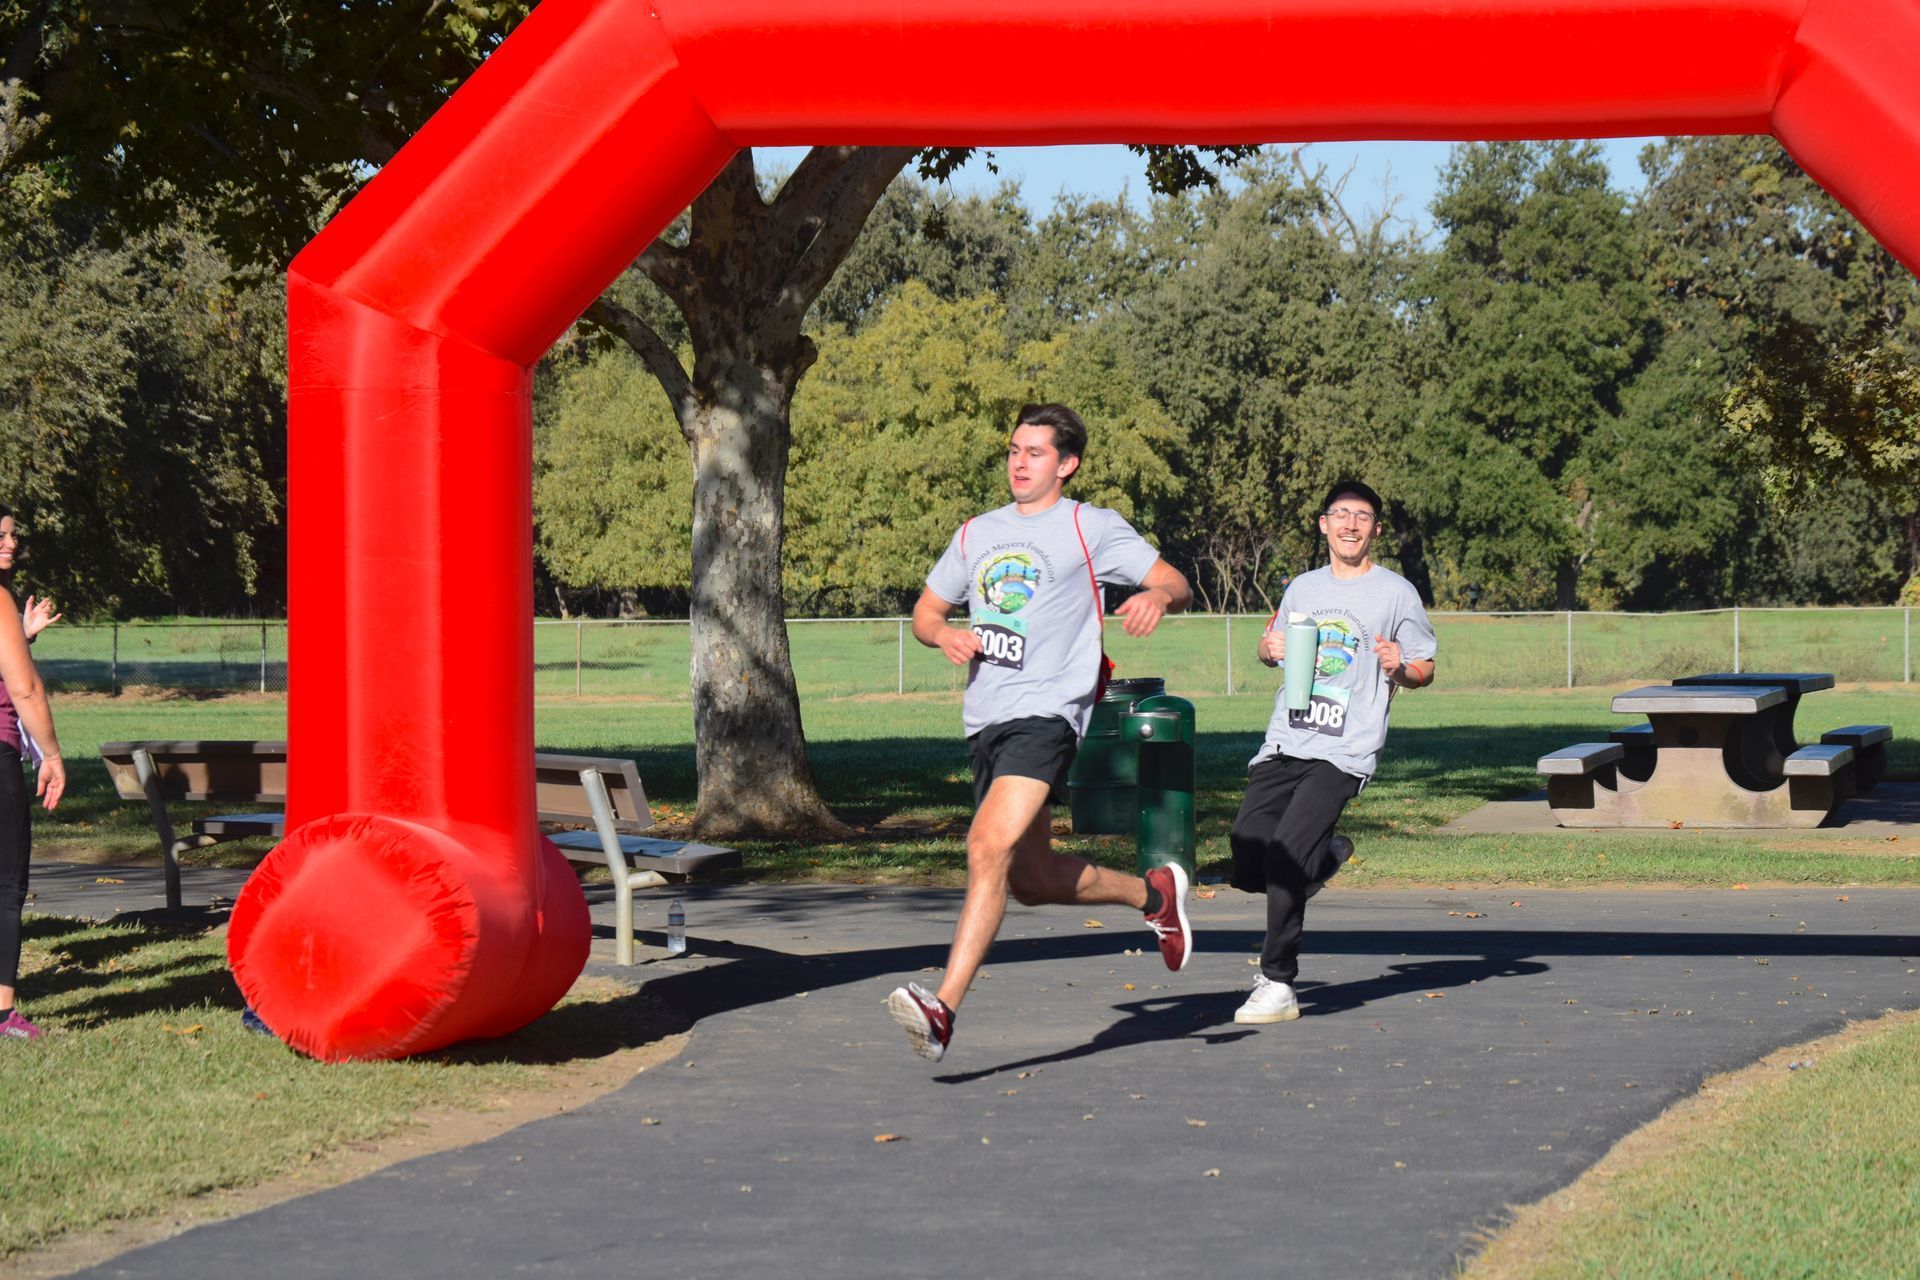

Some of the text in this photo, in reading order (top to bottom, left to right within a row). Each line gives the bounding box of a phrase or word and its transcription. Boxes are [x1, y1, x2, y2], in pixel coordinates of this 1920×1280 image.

[992, 541, 1025, 553] Meyers
[1026, 541, 1056, 583] Foundation
[1312, 608, 1370, 652] Meyers Foundation
